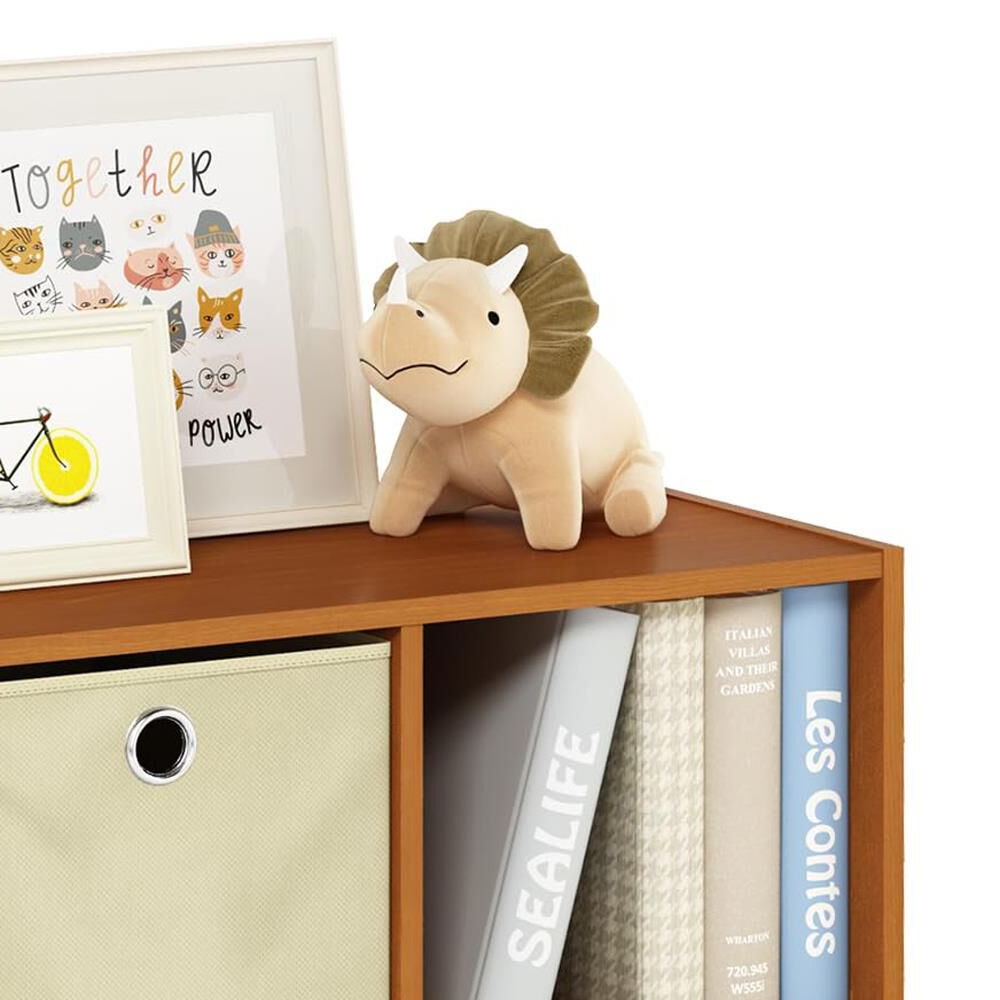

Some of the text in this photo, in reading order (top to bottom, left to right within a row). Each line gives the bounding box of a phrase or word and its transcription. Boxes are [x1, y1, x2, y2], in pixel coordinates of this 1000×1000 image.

[724, 625, 773, 641] ITALIAN
[728, 643, 771, 659] VILLAS
[715, 660, 778, 678] AND THEIR
[720, 680, 776, 697] GARDENS
[805, 690, 843, 958] Les Contes
[507, 724, 601, 968] SEALIFE
[726, 962, 769, 978] 720.945
